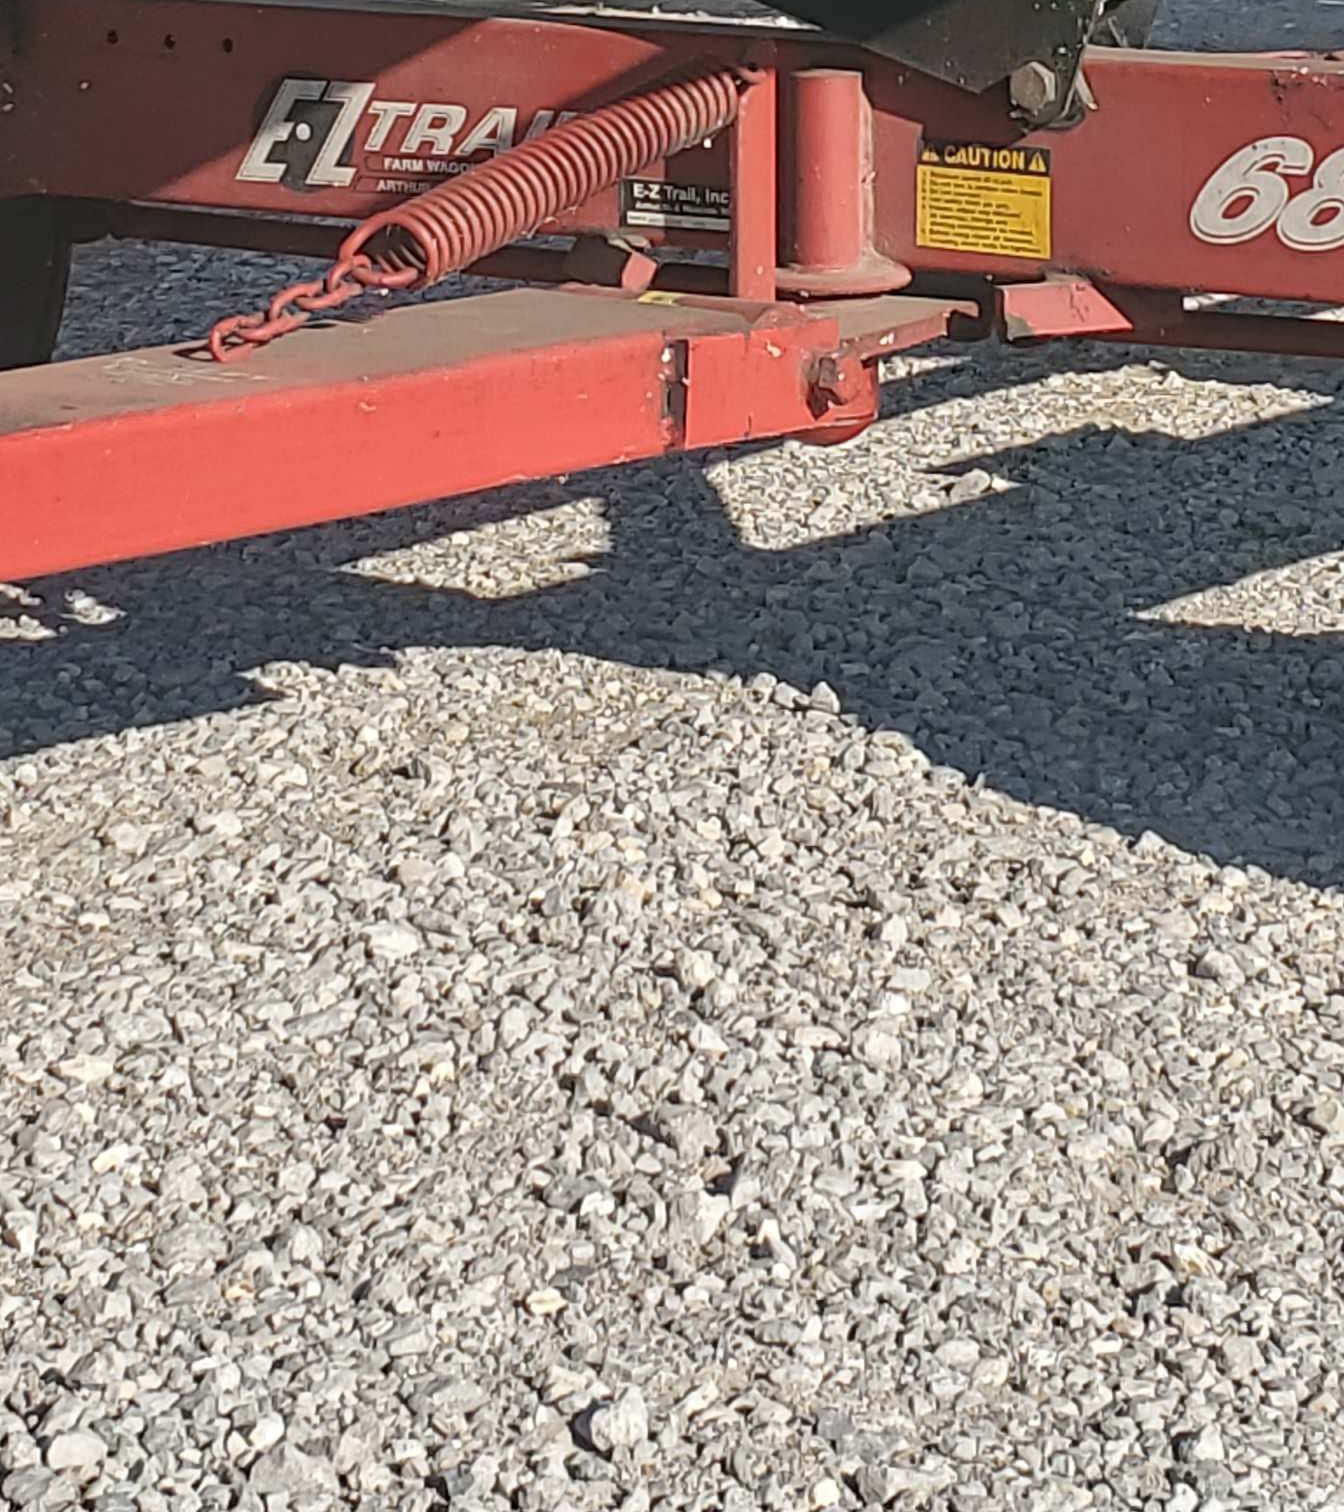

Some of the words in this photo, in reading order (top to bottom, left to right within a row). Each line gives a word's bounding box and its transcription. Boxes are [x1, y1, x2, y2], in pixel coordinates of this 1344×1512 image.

[383, 157, 424, 173] FARM
[943, 144, 1025, 171] CAUTION
[633, 182, 661, 199] E-Z
